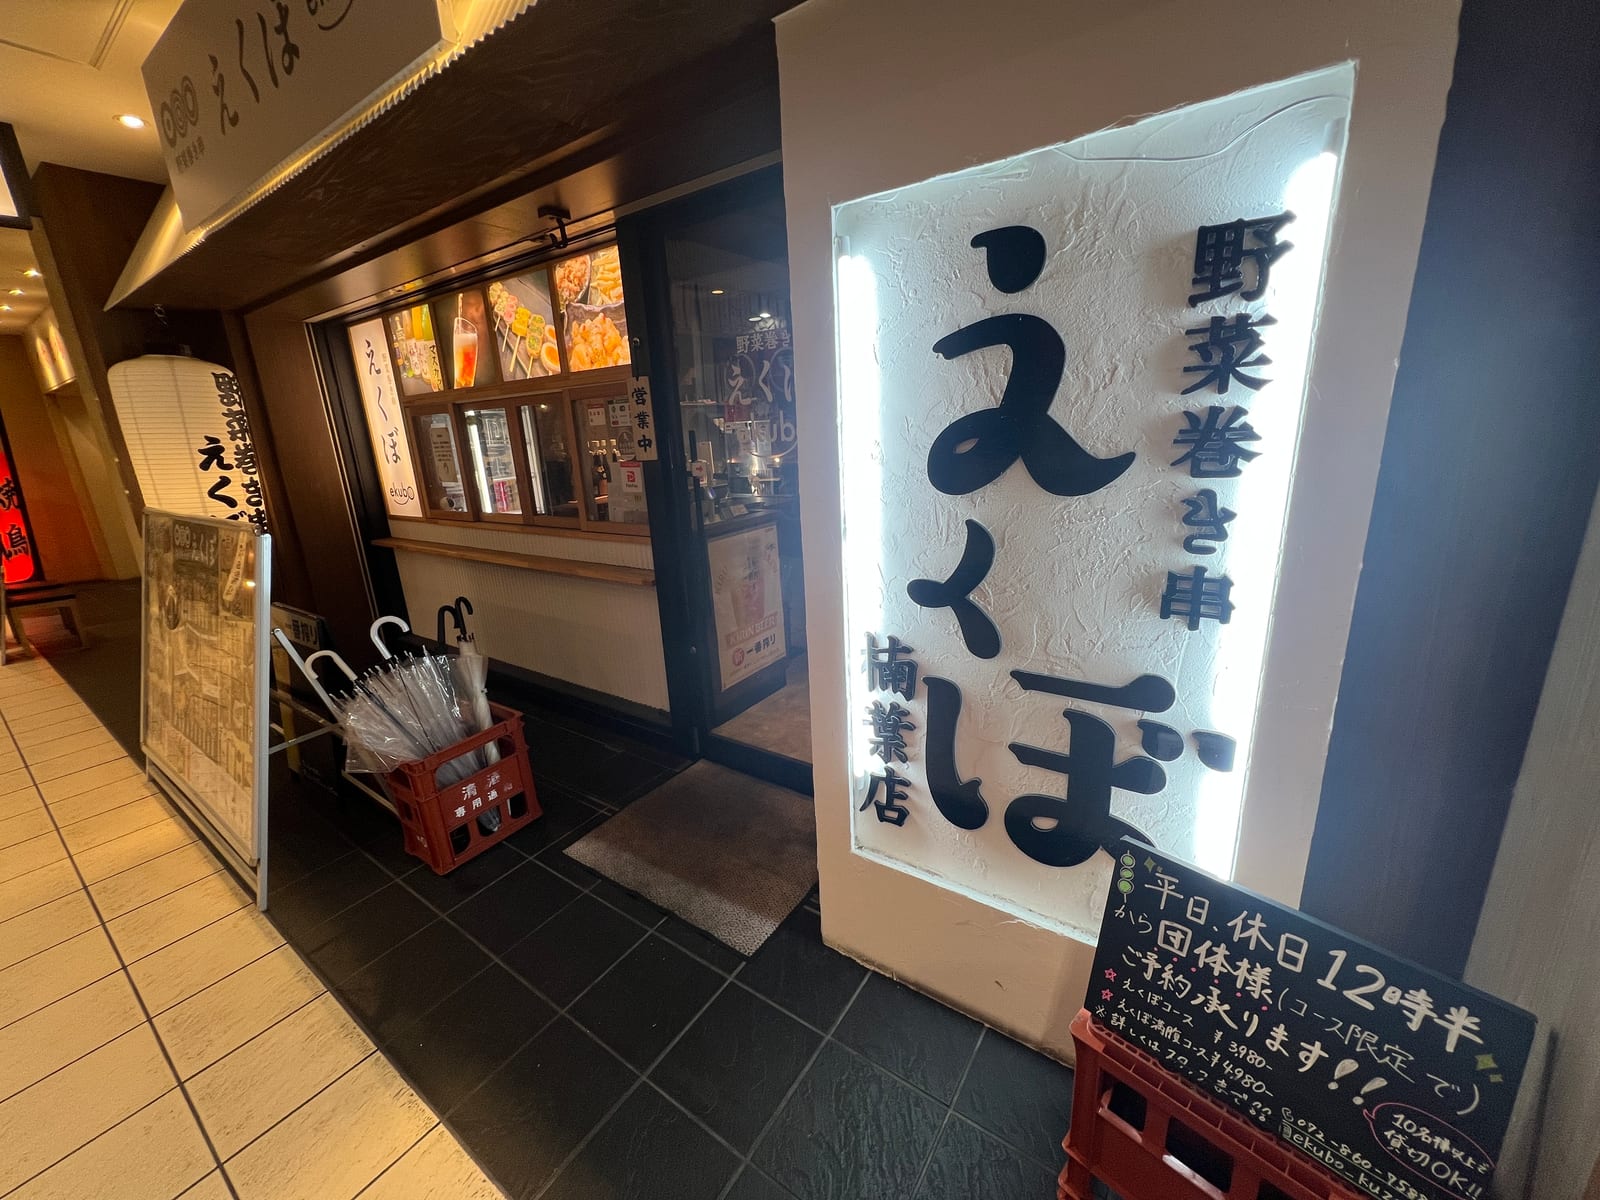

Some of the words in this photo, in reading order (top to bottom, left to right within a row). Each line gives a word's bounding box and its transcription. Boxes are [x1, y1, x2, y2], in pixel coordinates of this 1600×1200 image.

[364, 339, 402, 464] えくぼ
[631, 386, 653, 453] 営業中
[1160, 210, 1297, 631] 野菜巻き串
[389, 482, 415, 501] ekubo
[907, 225, 1236, 868] えくぼ
[1122, 978, 1194, 1028] えくぼコース
